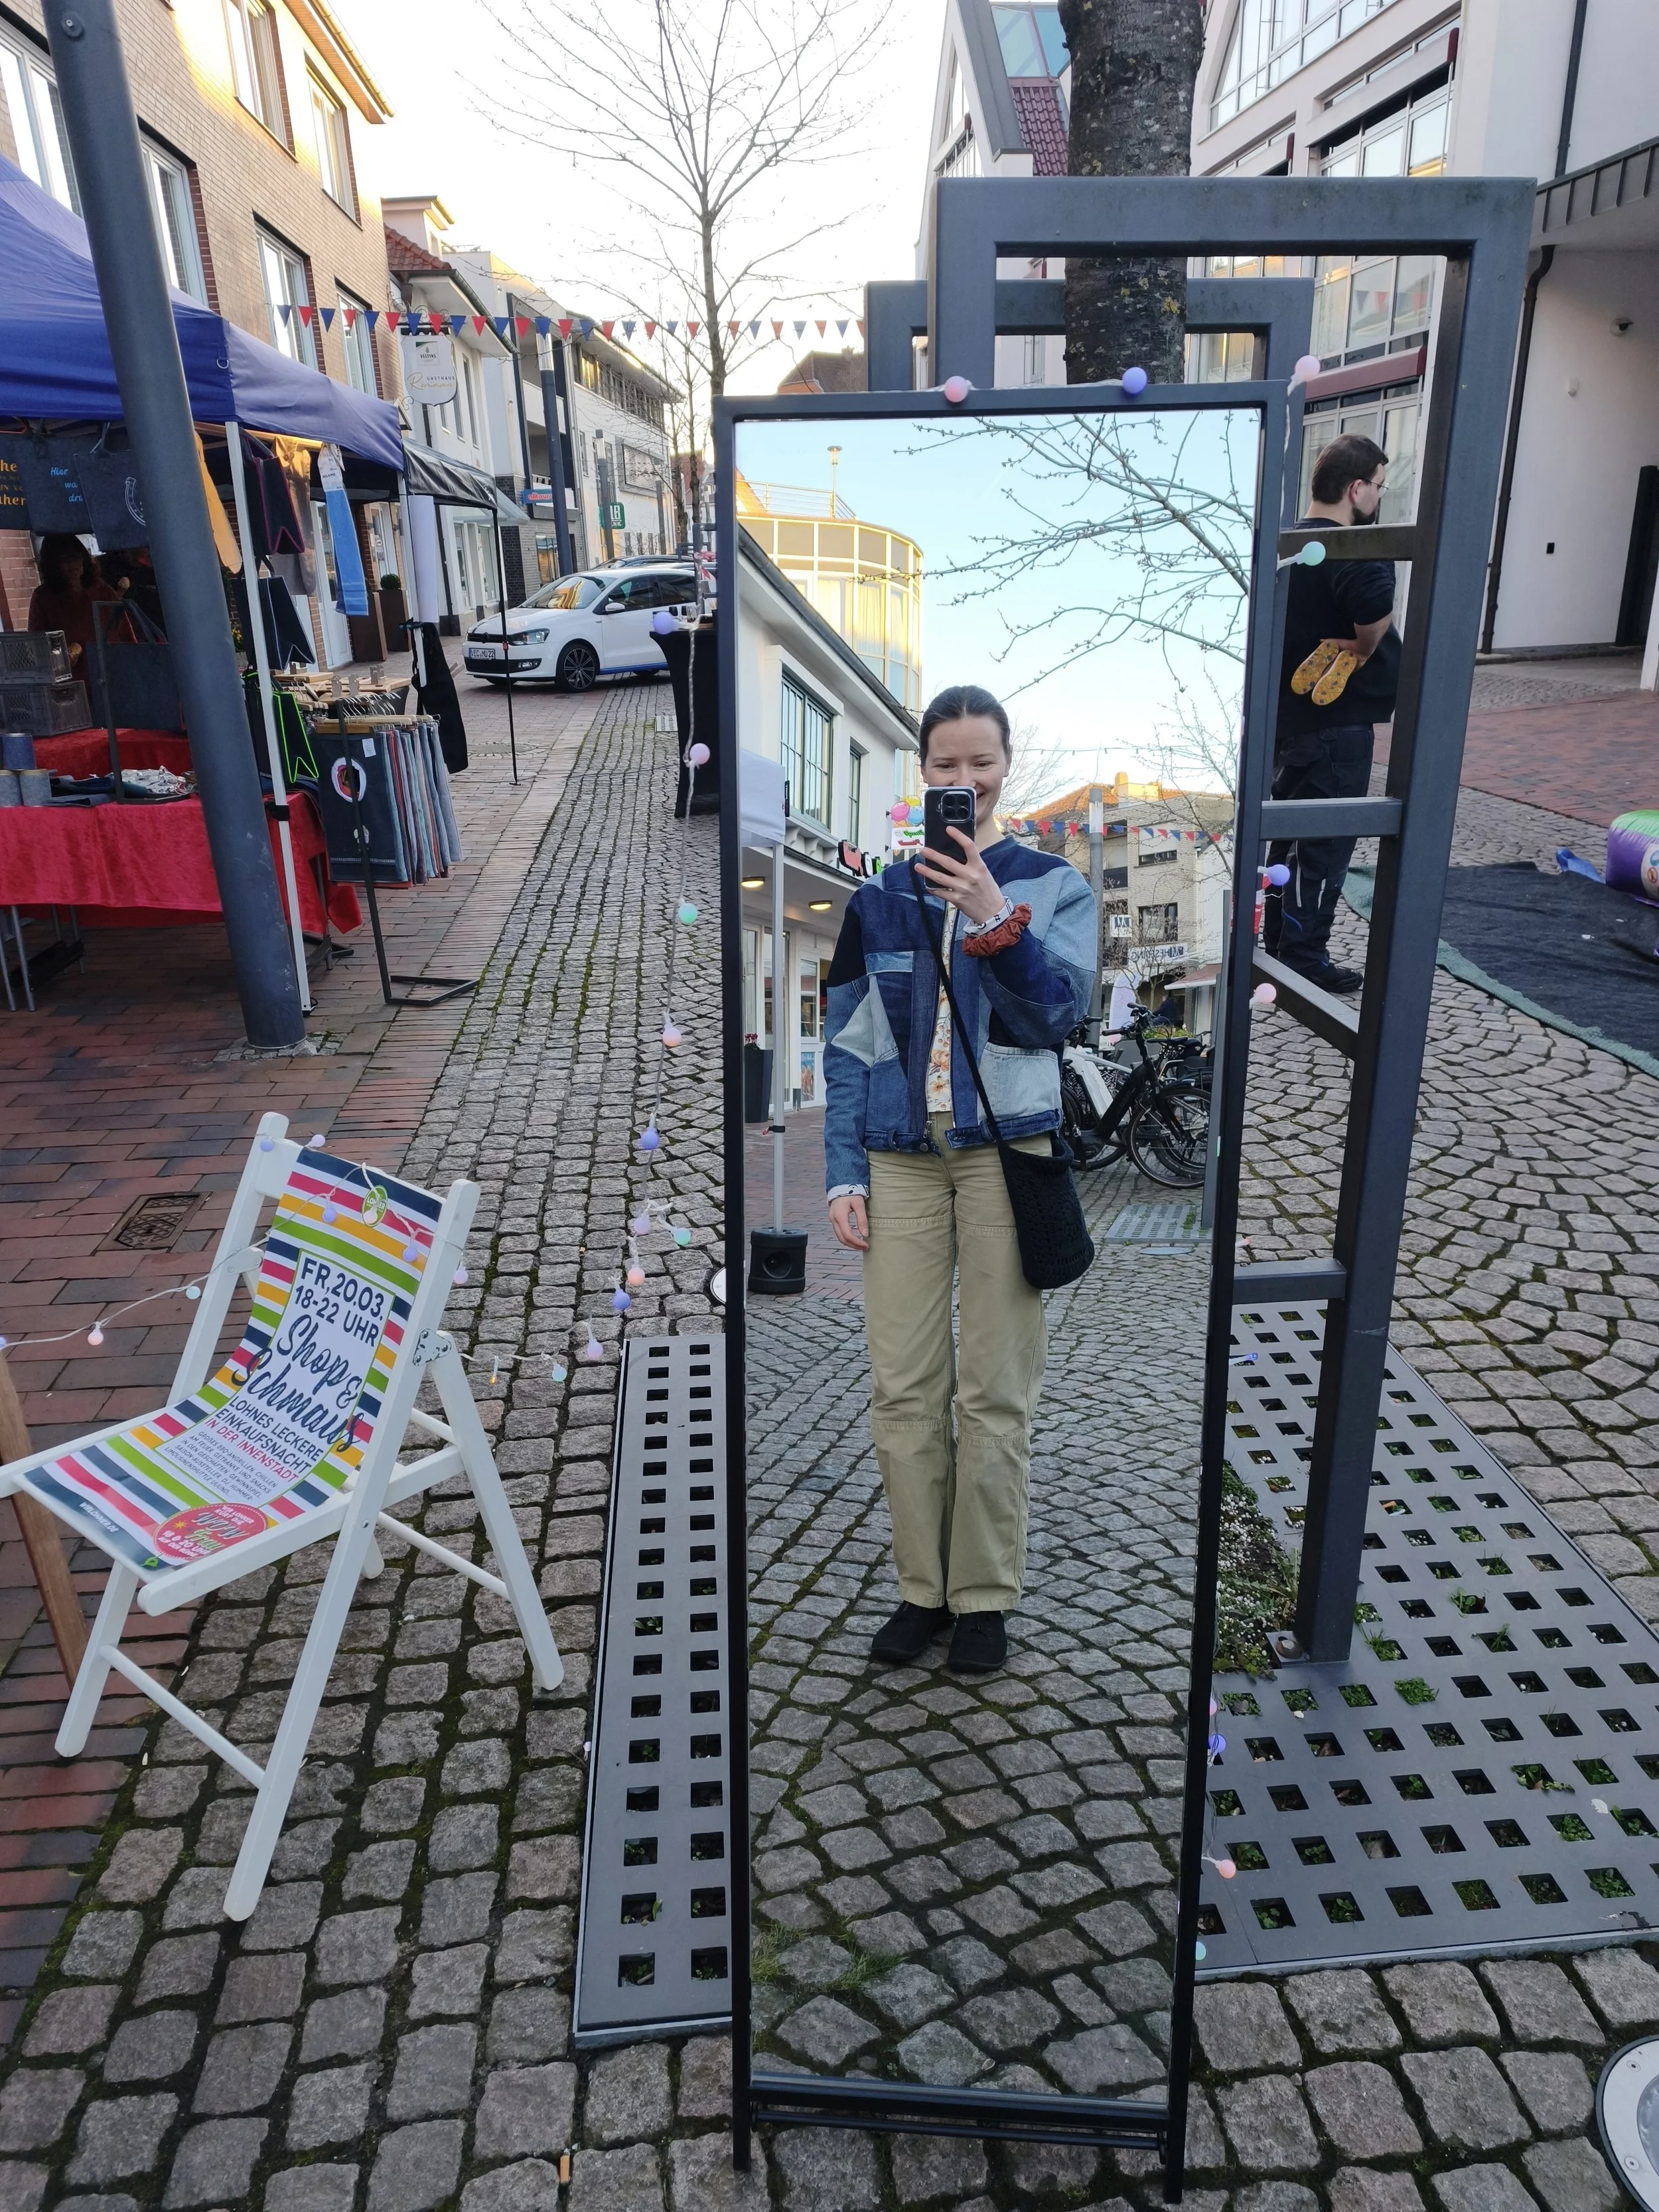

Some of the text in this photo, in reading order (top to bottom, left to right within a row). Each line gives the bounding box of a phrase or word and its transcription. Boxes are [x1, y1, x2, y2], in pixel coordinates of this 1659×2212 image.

[50, 467, 68, 476] Hier
[610, 505, 621, 520] LB
[295, 1286, 379, 1347] 18-22 UHR
[232, 1347, 364, 1452] Schmaus
[215, 1408, 311, 1473] EINKAUFSNACHT
[229, 1396, 323, 1461] LOHNES LECKERE
[187, 1443, 199, 1452] DEN
[205, 1418, 299, 1482] IN DER INNENSTADT
[165, 1447, 212, 1481] LIMOUSINENSHUTTLE
[239, 1470, 252, 1479] UND
[250, 1479, 271, 1494] SNACKS
[255, 1472, 278, 1487] CHILLEN
[191, 1512, 250, 1540] WOW
[191, 1546, 211, 1555] UHR
